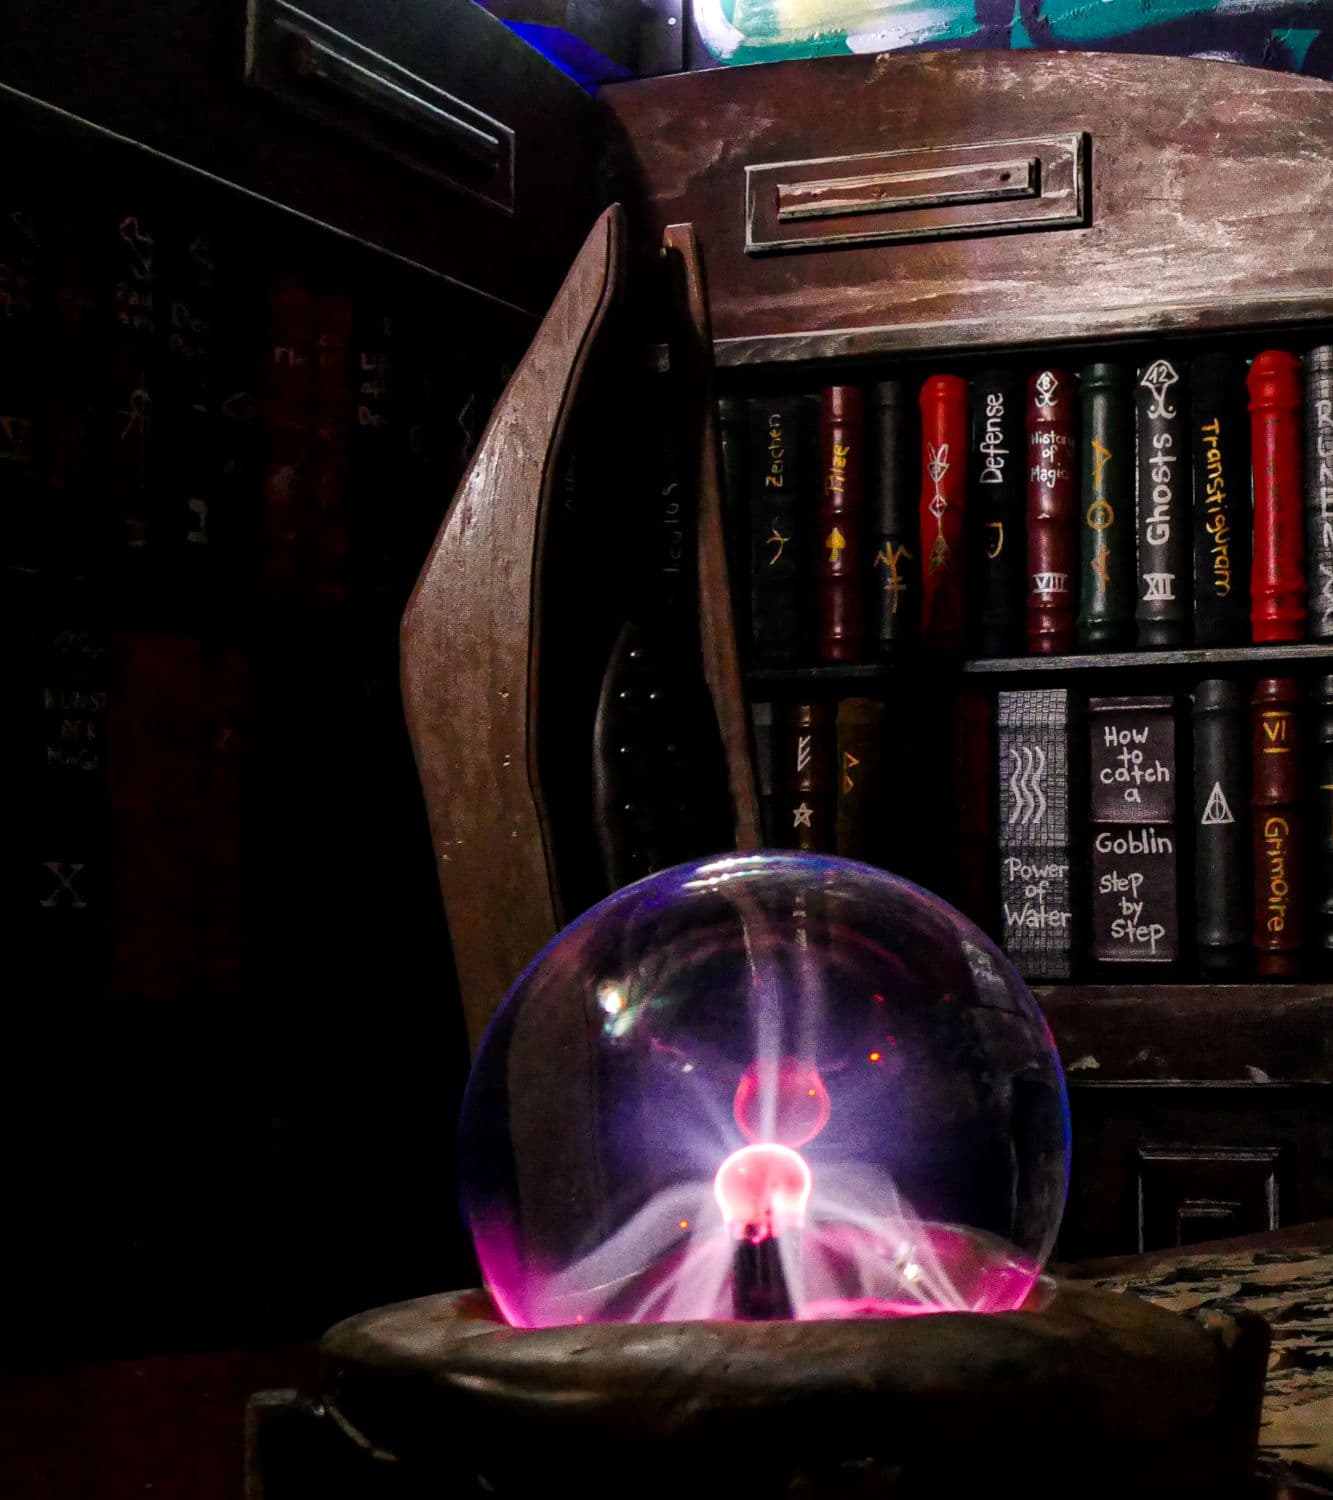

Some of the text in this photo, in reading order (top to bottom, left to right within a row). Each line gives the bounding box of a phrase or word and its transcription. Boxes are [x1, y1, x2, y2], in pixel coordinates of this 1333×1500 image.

[765, 413, 783, 487] Zeichen
[979, 392, 1009, 484] Defense
[1042, 445, 1057, 459] of
[1030, 462, 1069, 488] Magic
[1146, 433, 1177, 546] Ghosts
[1033, 573, 1069, 593] VIII
[1142, 573, 1176, 600] XII
[1103, 725, 1148, 745] How
[1117, 748, 1143, 765] to
[1099, 761, 1170, 785] catch
[1124, 788, 1141, 803] a
[1095, 828, 1173, 854] Goblin
[1004, 857, 1069, 880] Power
[1262, 817, 1290, 933] Grimoire
[1024, 881, 1050, 900] of
[1004, 903, 1073, 929] Water
[1119, 897, 1144, 924] by
